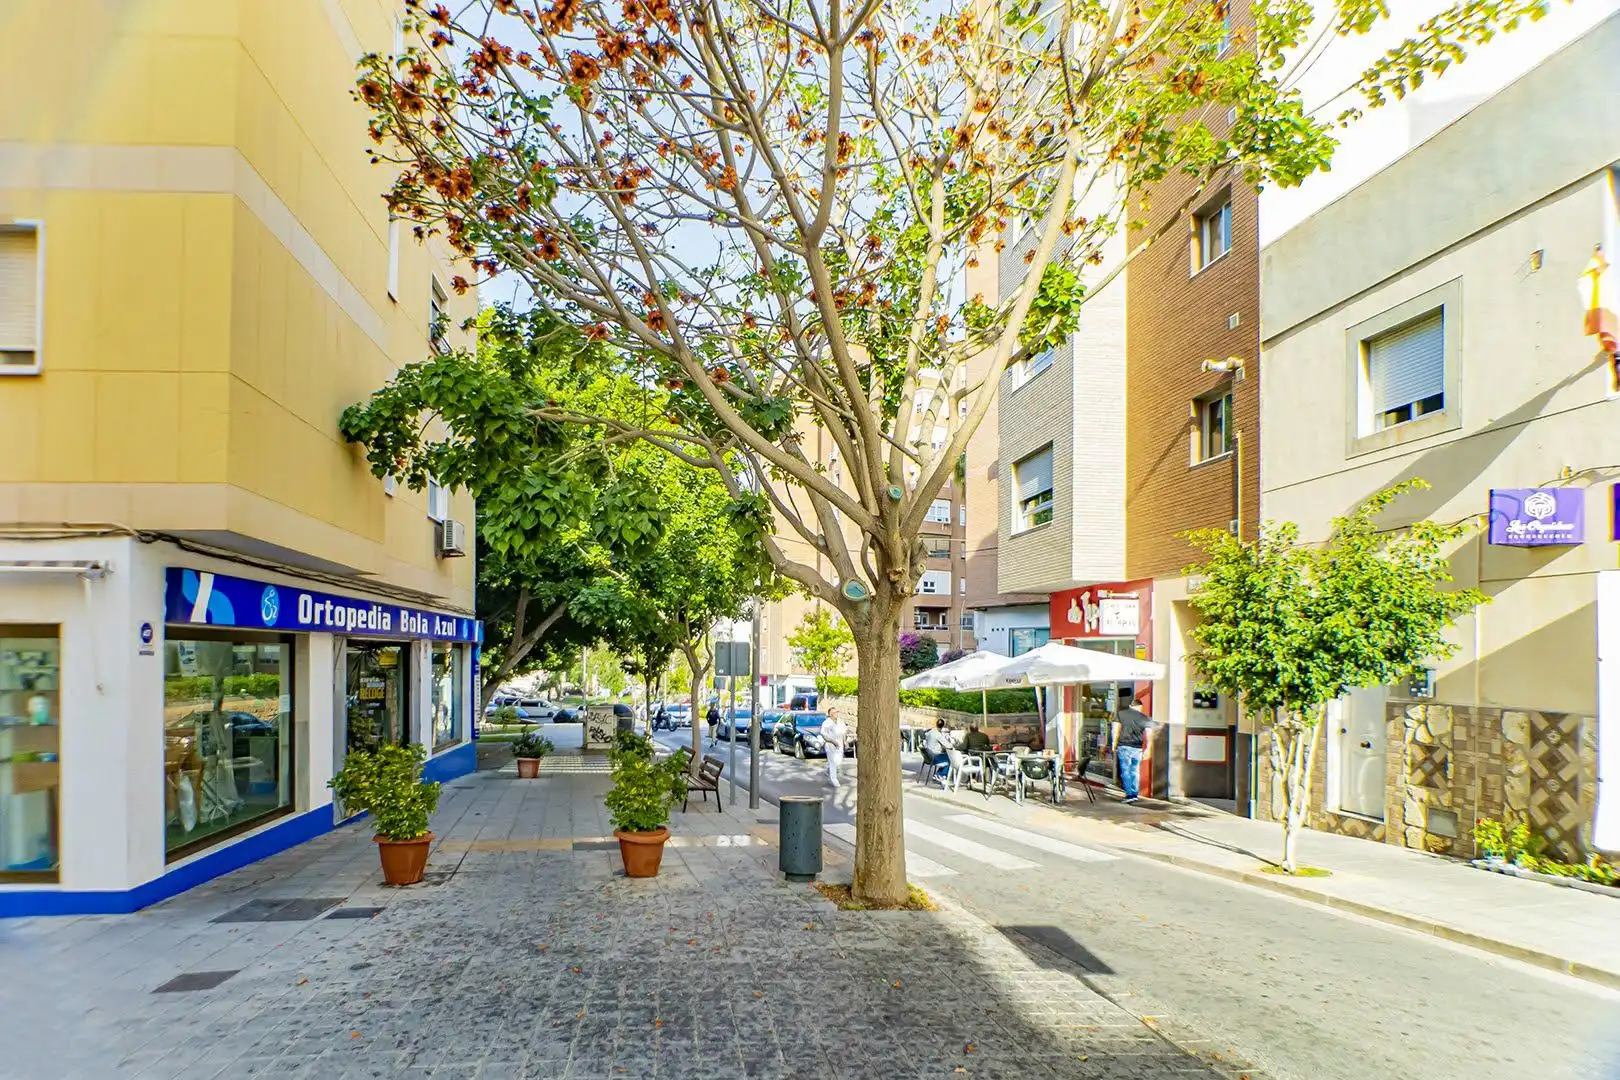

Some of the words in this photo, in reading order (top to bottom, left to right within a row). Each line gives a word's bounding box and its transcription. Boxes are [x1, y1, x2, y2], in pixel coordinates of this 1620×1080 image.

[298, 593, 391, 631] Ortopedia
[400, 609, 428, 634] Bola
[434, 615, 457, 636] Azul
